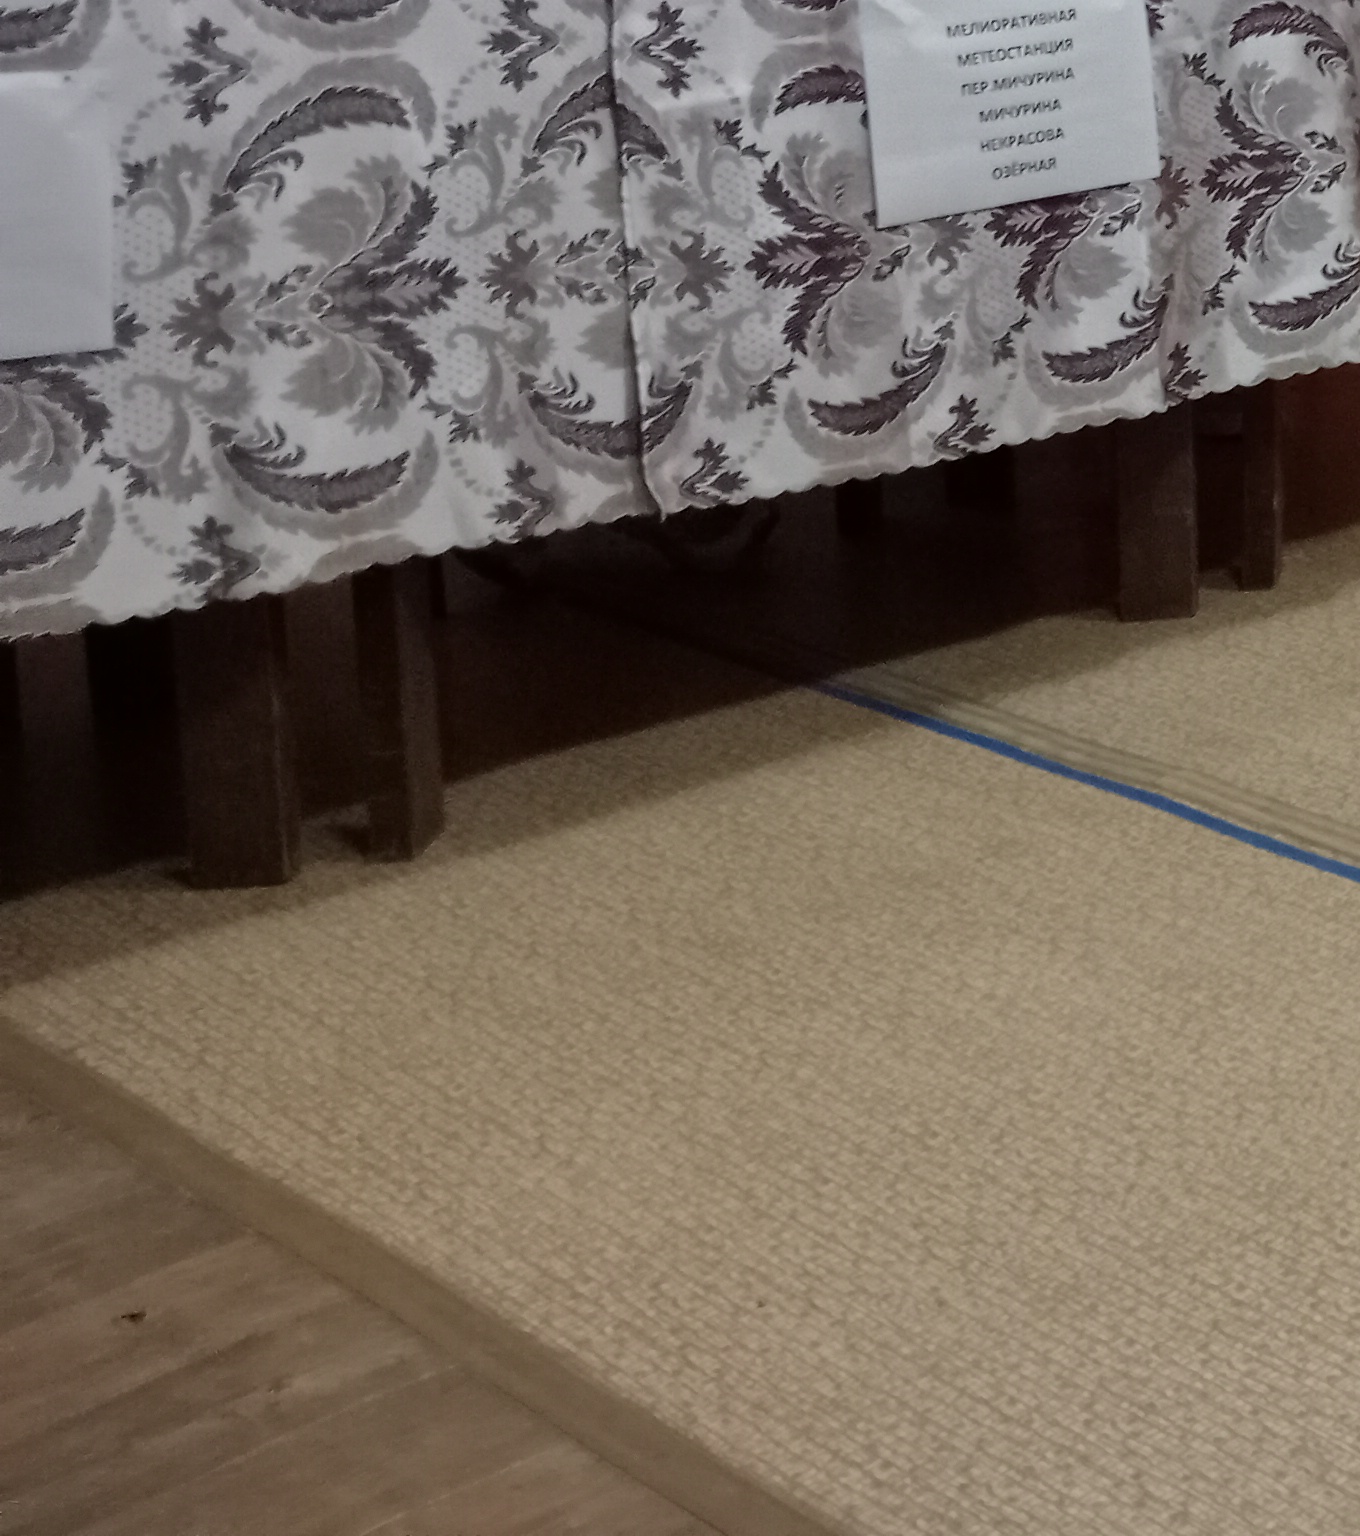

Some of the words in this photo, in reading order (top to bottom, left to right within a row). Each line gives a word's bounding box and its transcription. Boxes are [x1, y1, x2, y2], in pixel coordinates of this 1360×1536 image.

[946, 7, 1078, 39] МЕЛИОРАТИВНАЯ
[956, 37, 1074, 68] МЕТЕОСТАНЦИЯ
[978, 98, 1063, 124] МИЧУРИНА
[980, 126, 1066, 153] НЕКРАСОВА
